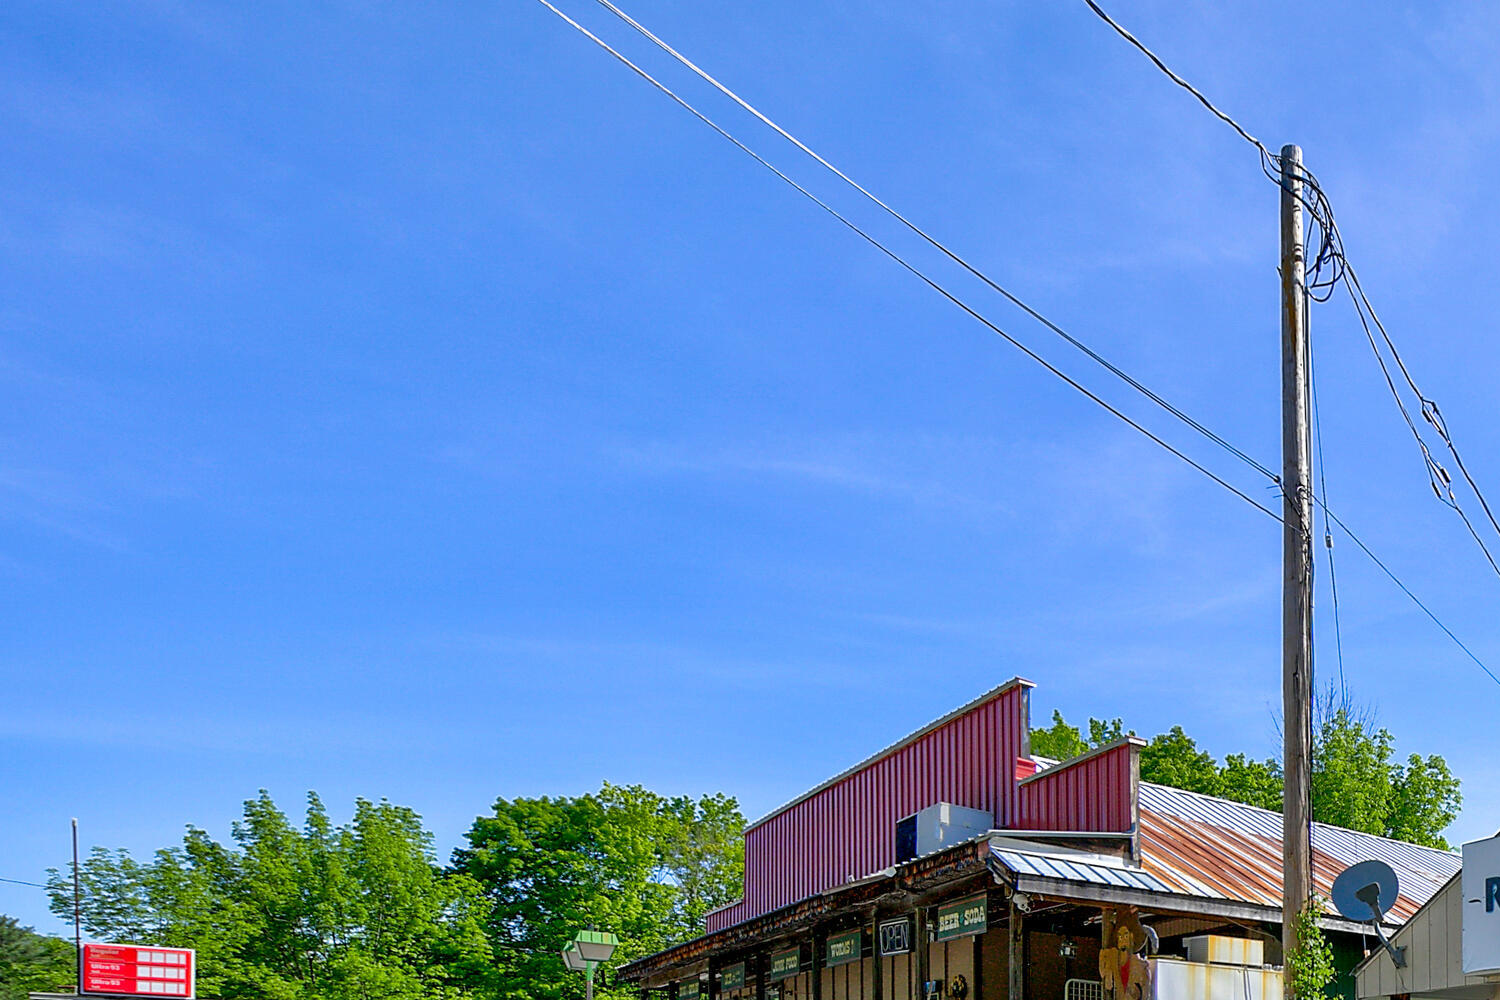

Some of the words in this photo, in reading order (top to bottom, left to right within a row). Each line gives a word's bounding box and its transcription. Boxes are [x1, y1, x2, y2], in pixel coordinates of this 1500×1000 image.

[939, 912, 959, 931] BEER
[964, 905, 985, 926] SODA
[881, 925, 909, 951] OPEN
